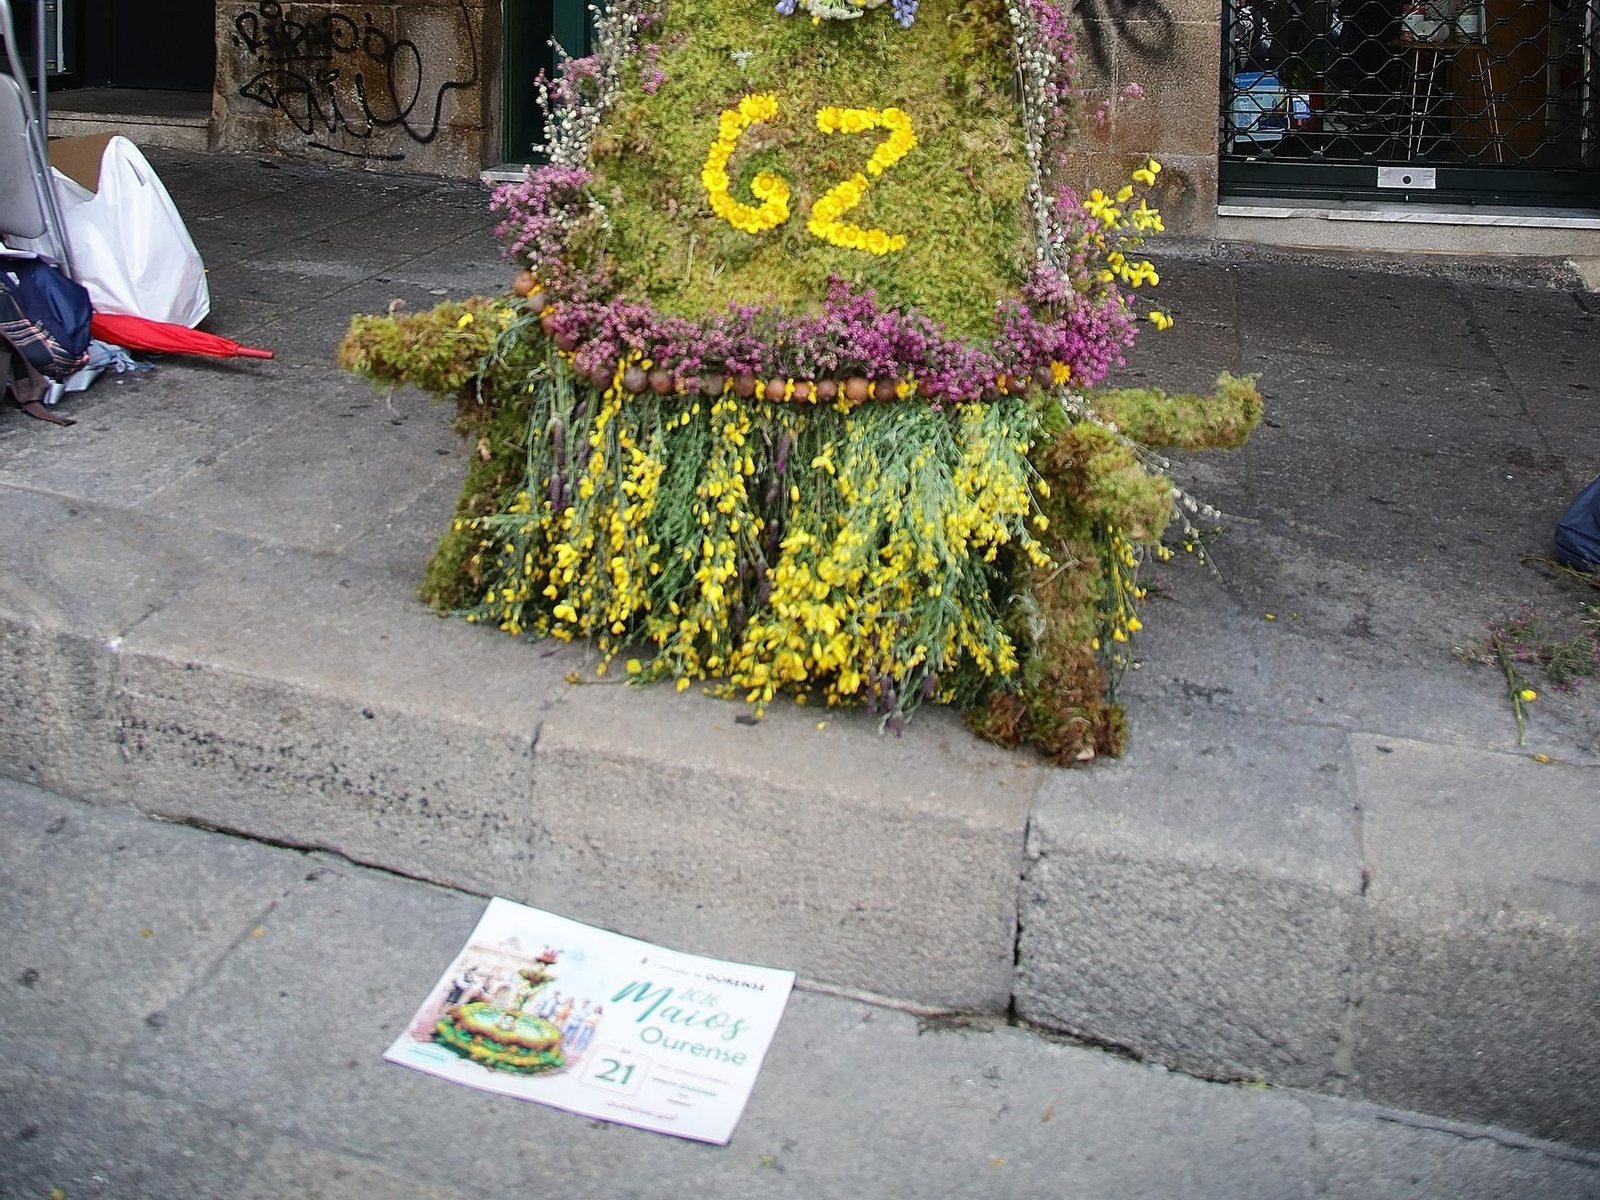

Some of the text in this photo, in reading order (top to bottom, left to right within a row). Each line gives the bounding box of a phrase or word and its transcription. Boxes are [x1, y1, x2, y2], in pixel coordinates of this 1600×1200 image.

[610, 981, 747, 1040] Maios
[639, 1026, 747, 1065] Ourense
[594, 1058, 636, 1086] 21
